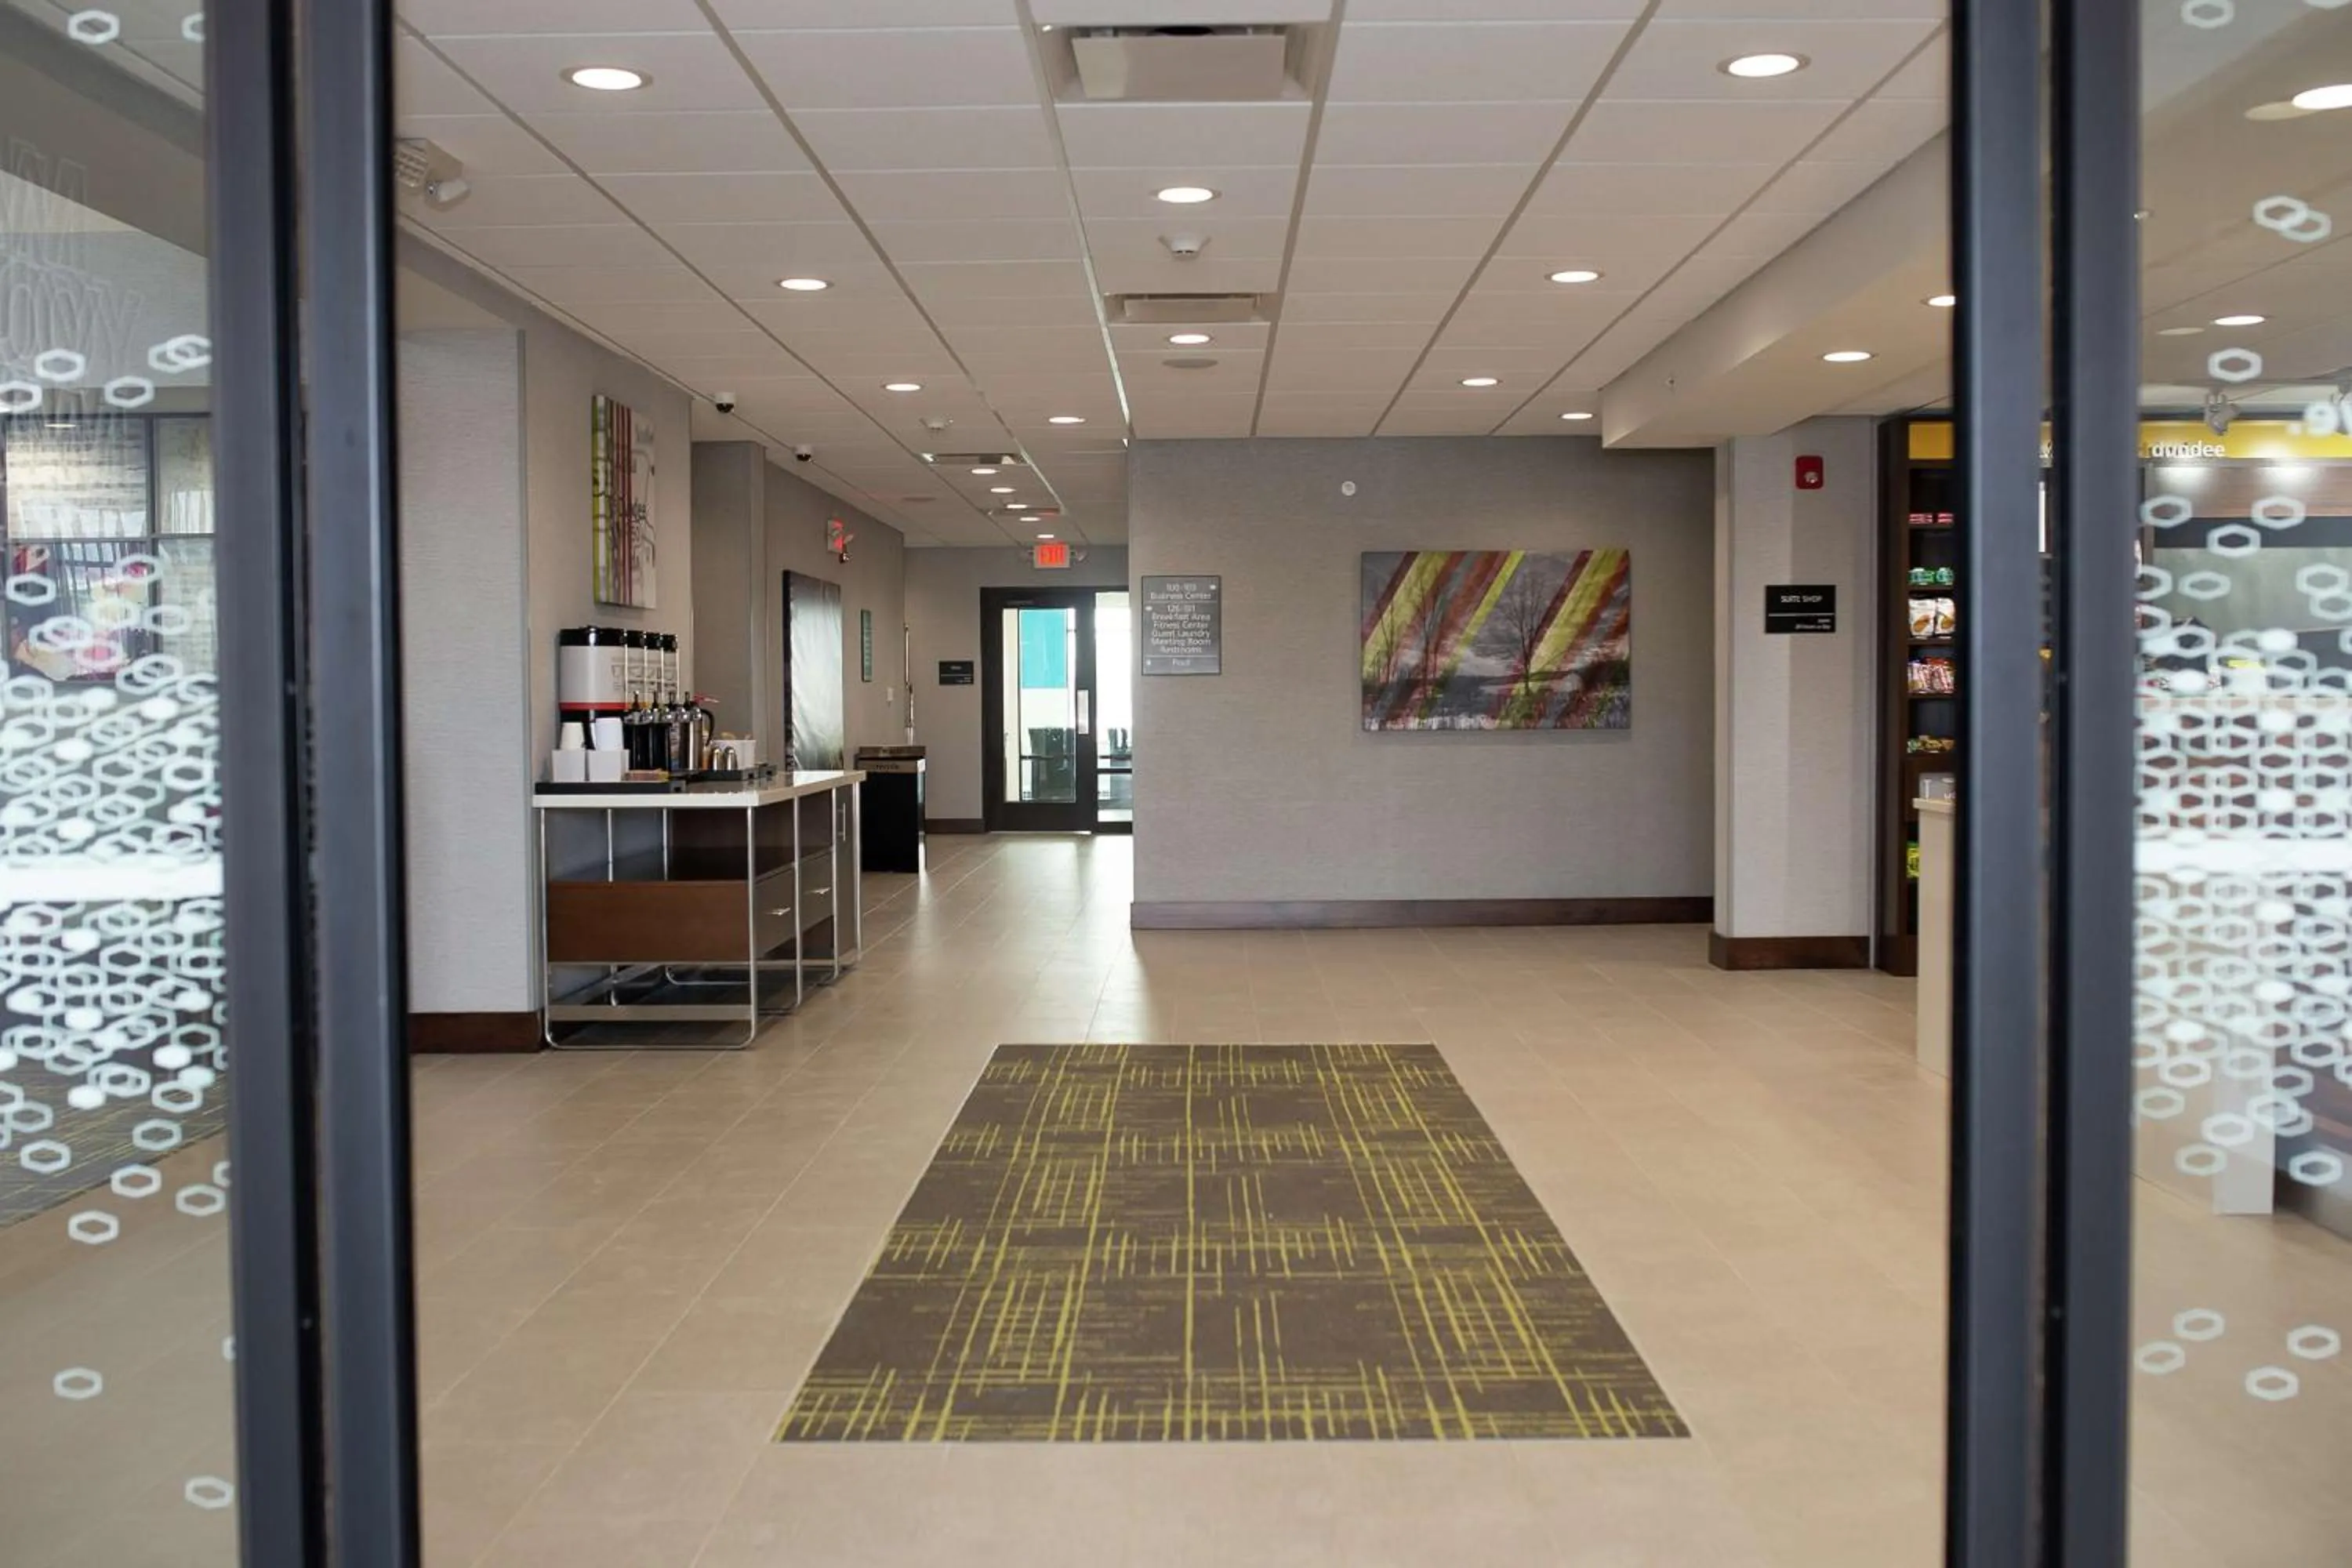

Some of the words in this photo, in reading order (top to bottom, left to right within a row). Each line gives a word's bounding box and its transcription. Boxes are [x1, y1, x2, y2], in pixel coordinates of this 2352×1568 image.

[1152, 612, 1189, 622] Breakfast
[1177, 630, 1211, 639] Laundry
[1151, 638, 1186, 647] Meeting
